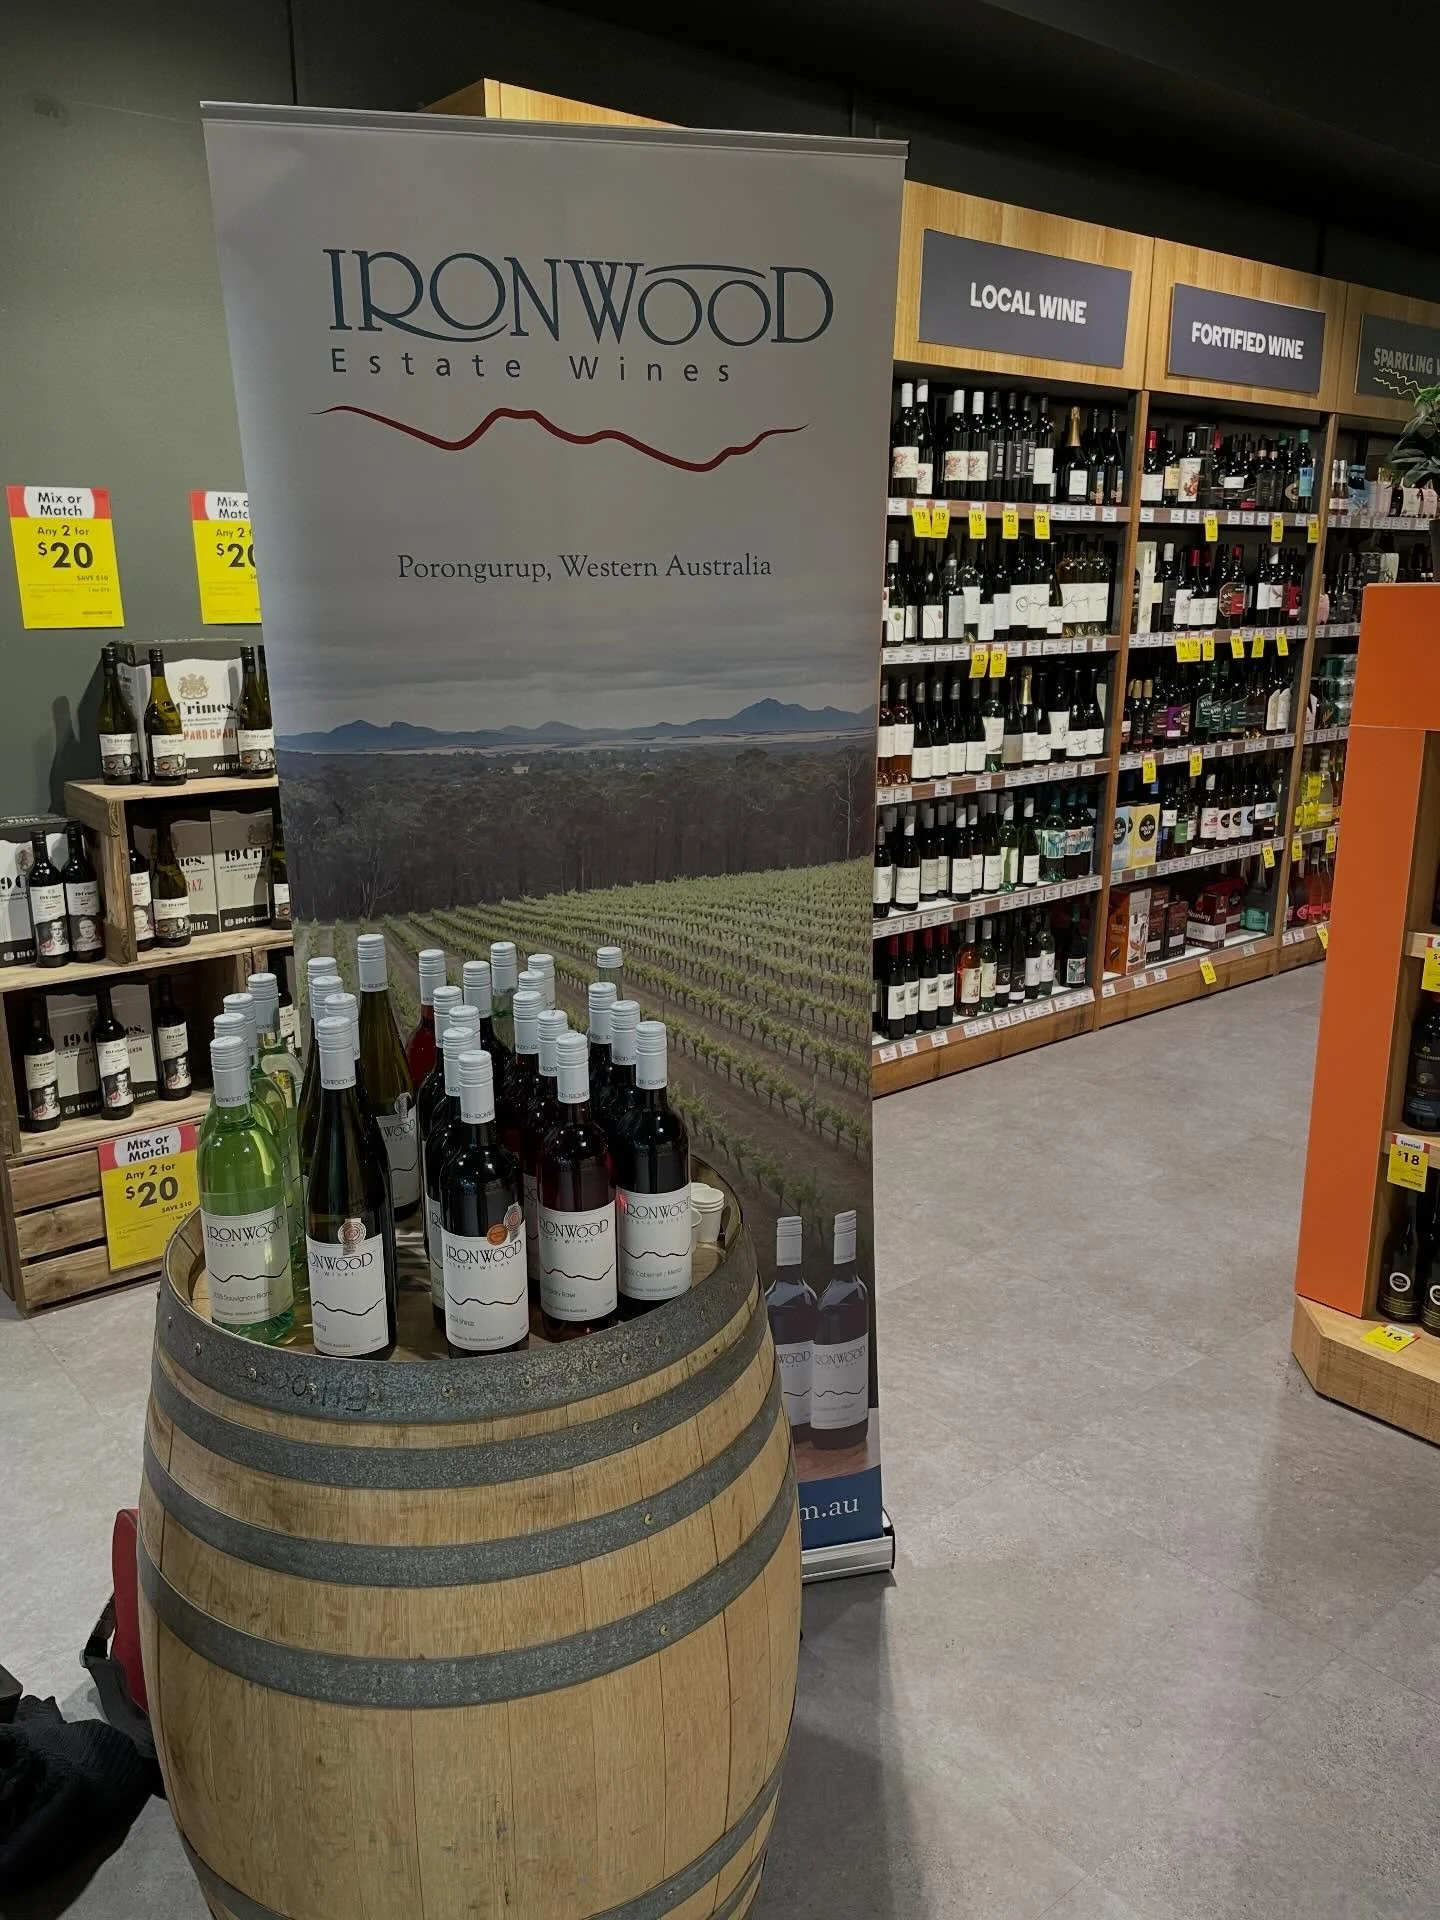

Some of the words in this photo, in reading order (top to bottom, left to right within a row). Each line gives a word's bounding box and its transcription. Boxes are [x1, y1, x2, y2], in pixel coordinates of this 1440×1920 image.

[322, 248, 834, 347] IRONWOOD
[970, 281, 1036, 317] LOCAL
[1039, 293, 1088, 325] WINE
[1191, 321, 1266, 354] FORTIFIED
[1268, 335, 1305, 360] WINE
[331, 348, 521, 378] Estate
[568, 355, 730, 382] Wines
[1374, 347, 1433, 375] SPARKLING
[38, 492, 63, 504] Mix
[67, 495, 82, 504] or
[217, 497, 239, 508] Mix
[40, 504, 83, 517] Match
[219, 508, 249, 520] Matc
[37, 527, 57, 537] Any
[61, 524, 71, 537] 2
[75, 527, 90, 536] for
[216, 529, 234, 539] Any
[237, 527, 246, 538] 2
[38, 541, 94, 569] $20
[397, 553, 553, 584] Porongurup,
[557, 552, 659, 578] Western
[664, 551, 773, 579] Australia
[383, 1118, 415, 1137] WOOD
[127, 1139, 150, 1151] Mix
[155, 1135, 170, 1145] or
[129, 1145, 169, 1162] Match
[1398, 1151, 1420, 1166] $18
[126, 1170, 145, 1180] Any
[148, 1165, 158, 1176] 2
[161, 1163, 176, 1172] for
[126, 1176, 179, 1208] $20
[162, 1204, 178, 1213] SAVE
[206, 1215, 284, 1243] IRONWOOD
[540, 1219, 609, 1239] RONWOOD
[309, 1252, 373, 1271] ONWOOD
[446, 1240, 522, 1264] IRONWOOD
[777, 1350, 811, 1364] WOOD
